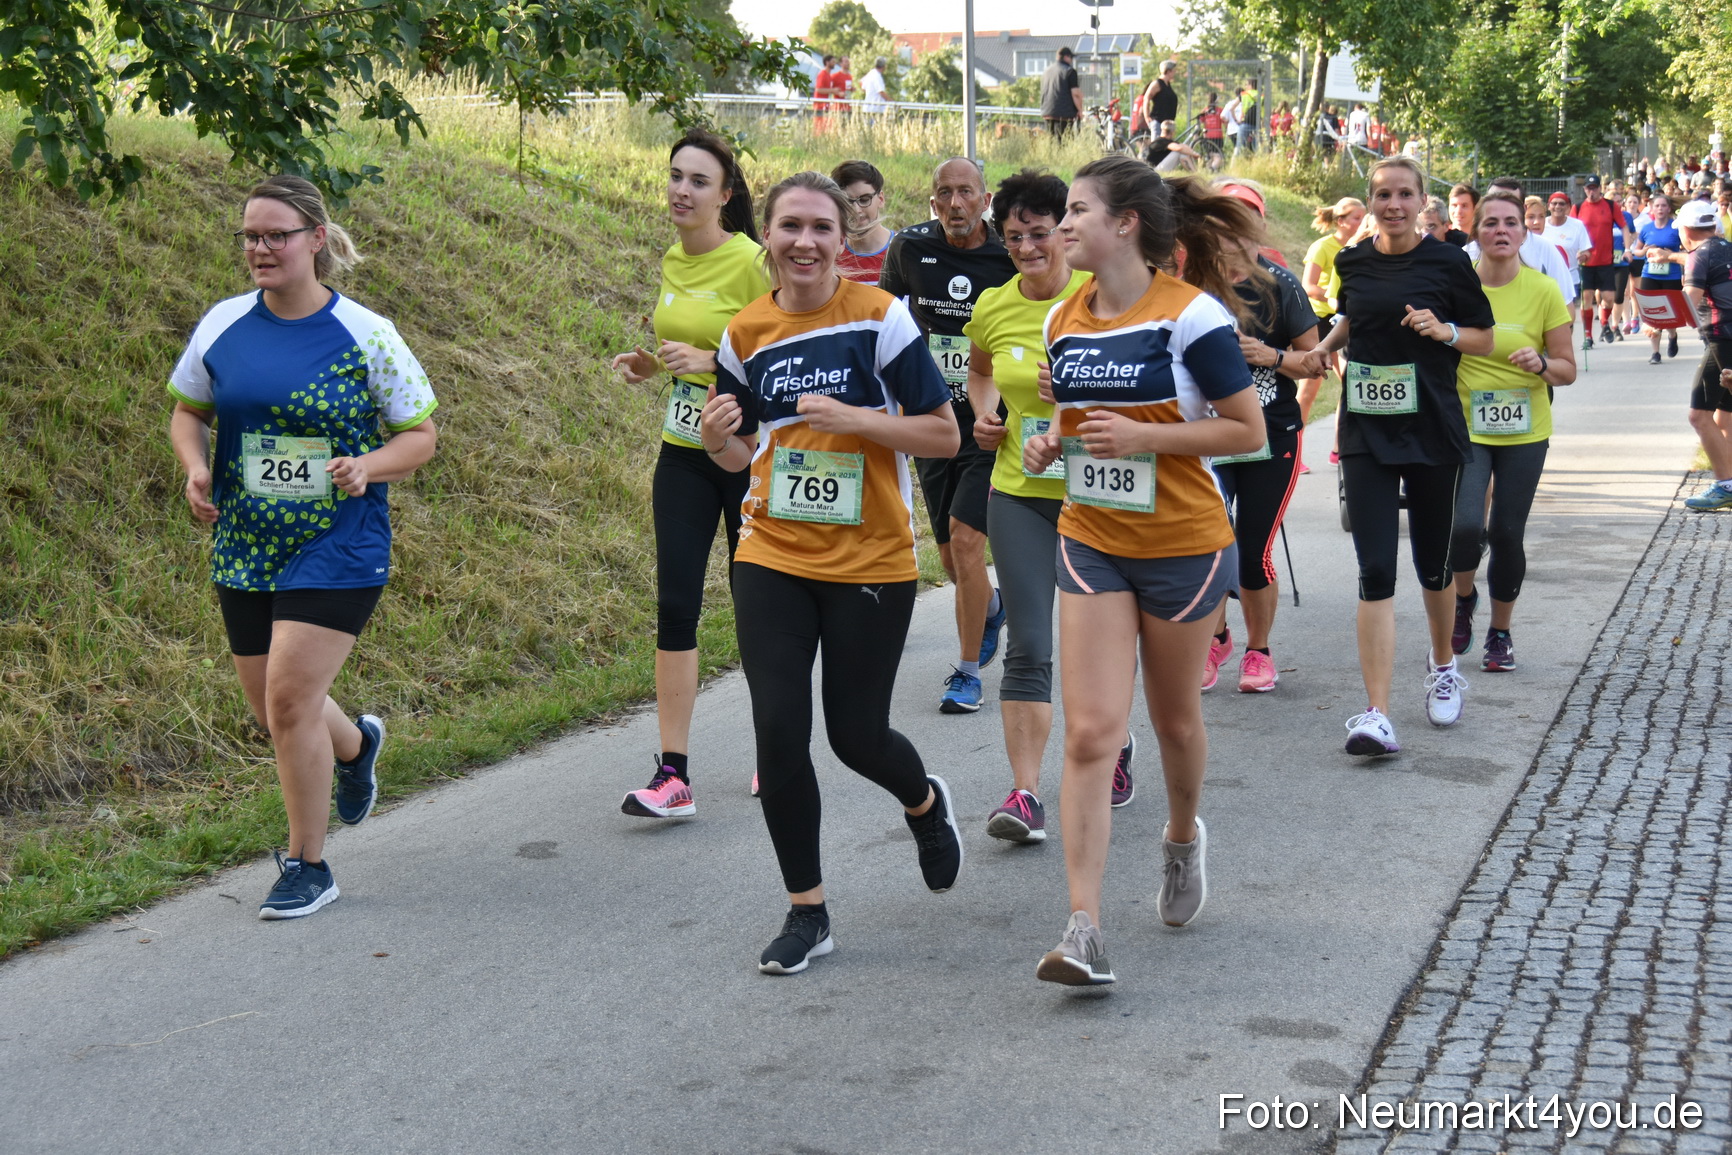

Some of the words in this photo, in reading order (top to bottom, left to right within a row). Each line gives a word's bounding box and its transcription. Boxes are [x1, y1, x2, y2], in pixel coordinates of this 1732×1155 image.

[1060, 360, 1145, 378] Fischer
[772, 368, 852, 395] Fischer
[1068, 380, 1137, 388] AUTOMOBILE
[1355, 382, 1406, 401] 1868
[675, 400, 702, 428] 127
[1478, 405, 1523, 422] 1304
[261, 458, 311, 482] 264
[1084, 464, 1135, 492] 9138
[259, 480, 284, 489] Schlierf
[788, 474, 838, 503] 769
[790, 501, 814, 510] Matura
